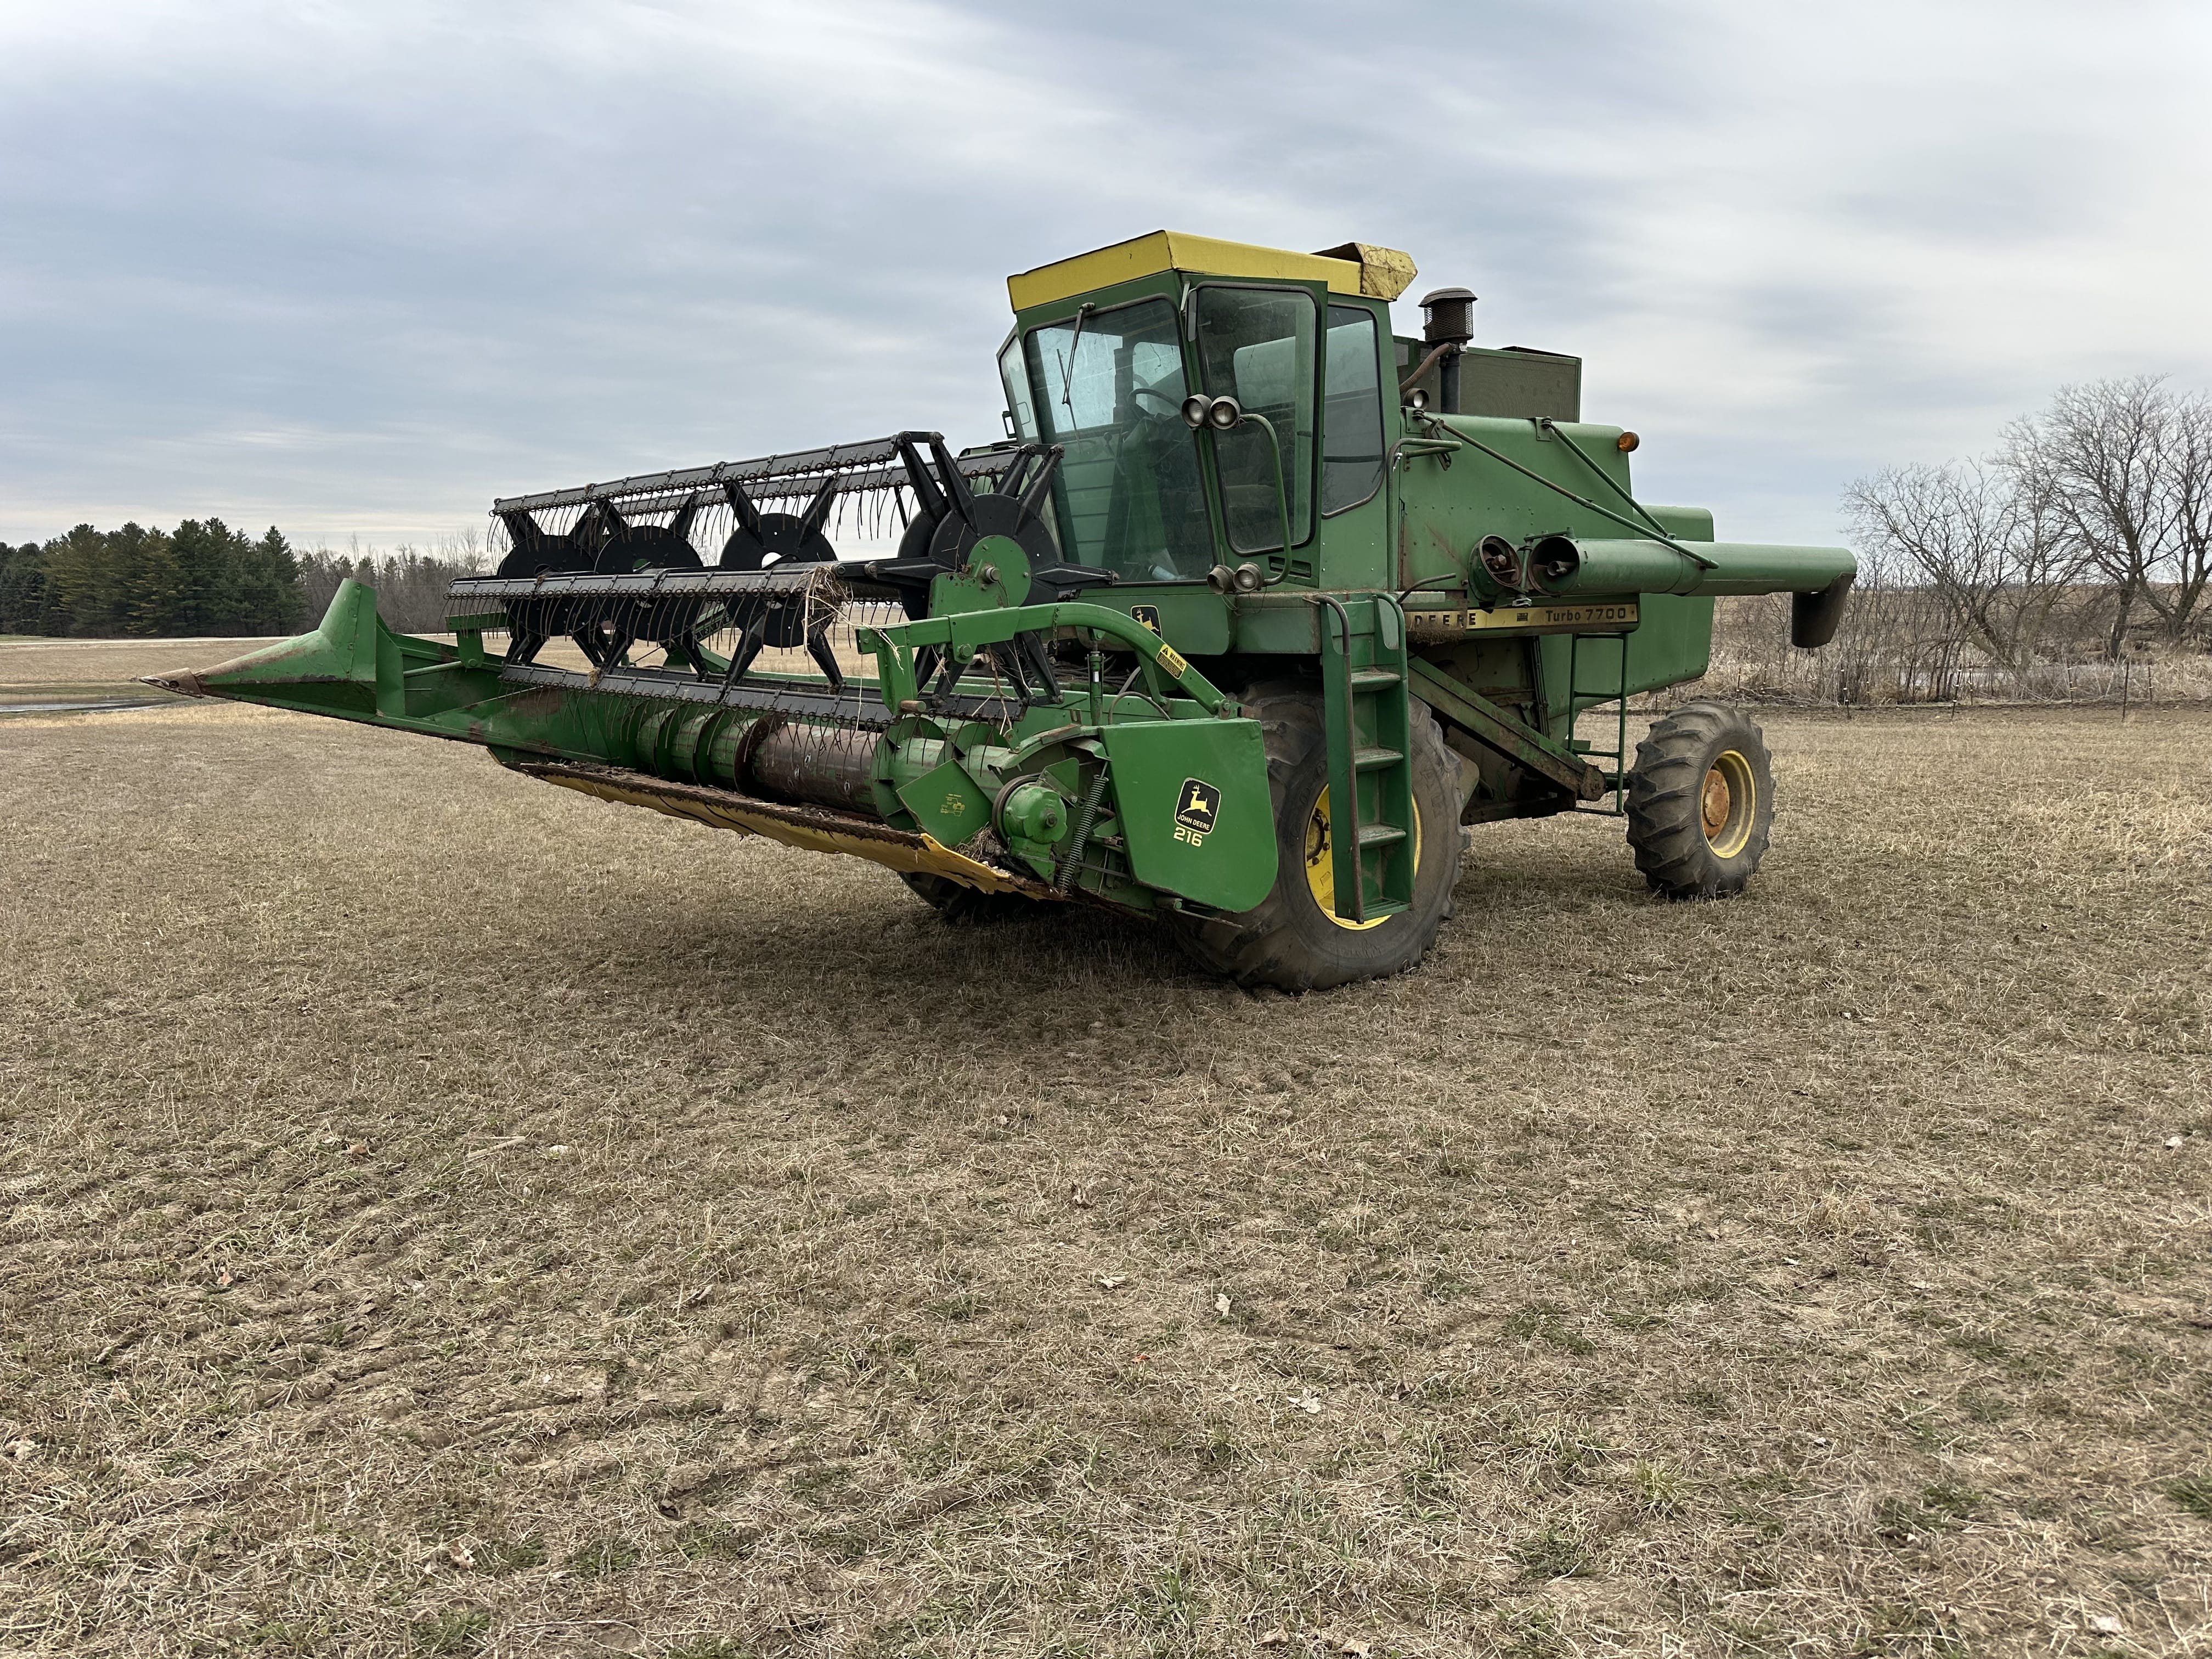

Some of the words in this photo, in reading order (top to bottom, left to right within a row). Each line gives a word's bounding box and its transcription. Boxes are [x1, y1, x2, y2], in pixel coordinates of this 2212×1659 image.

[1545, 610, 1581, 622] Turbo
[1585, 608, 1626, 620] 7700
[1169, 652, 1185, 670] WARNING
[1177, 814, 1193, 824] JOHN
[1192, 819, 1210, 831] DEERE
[1173, 827, 1203, 847] 216
